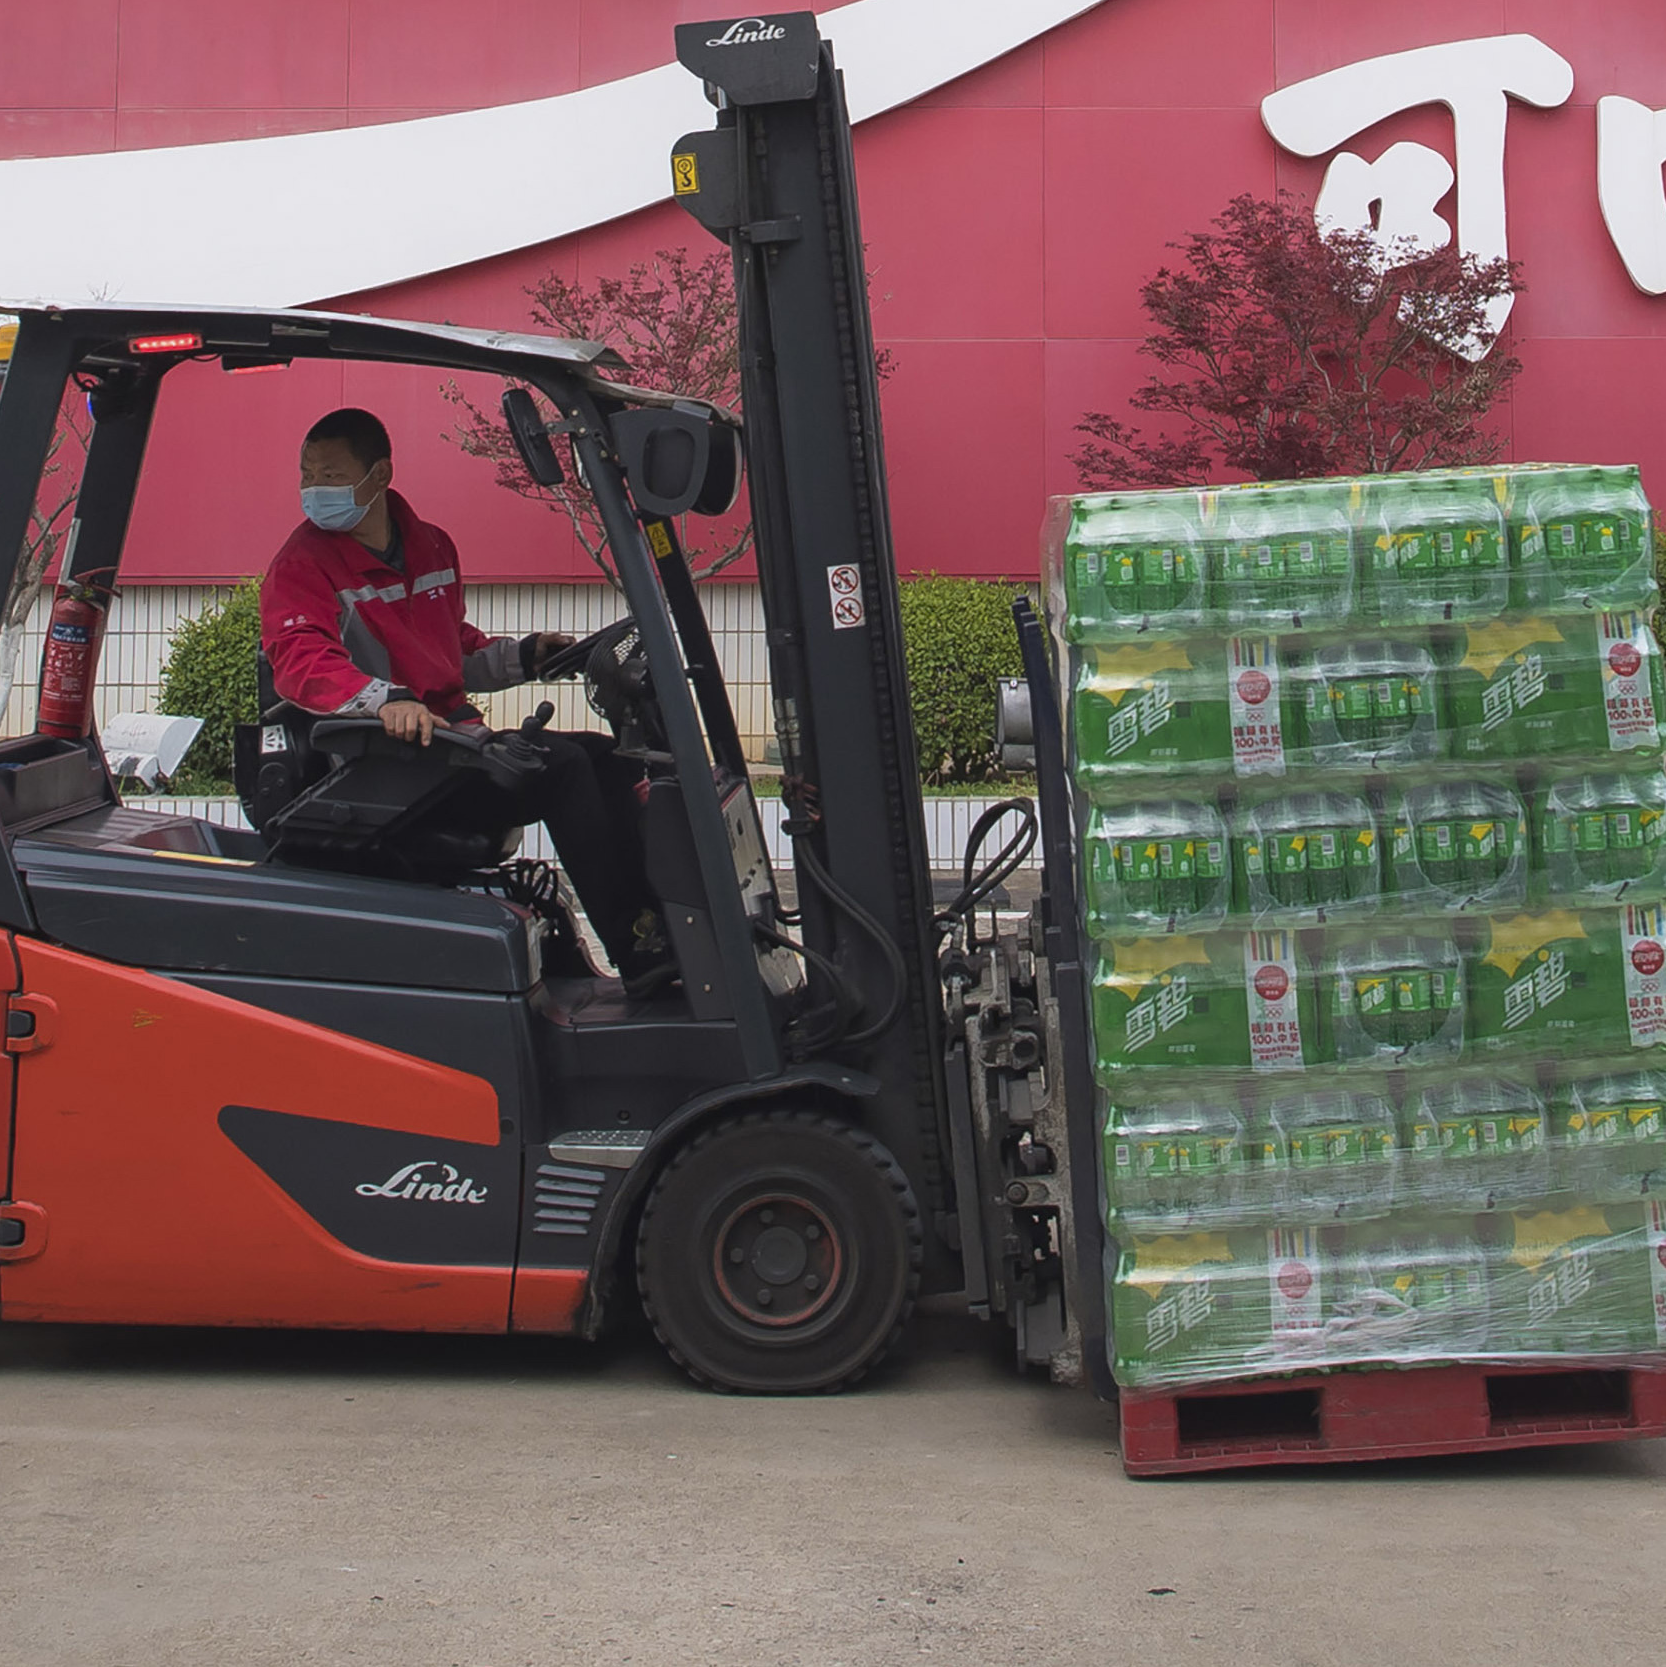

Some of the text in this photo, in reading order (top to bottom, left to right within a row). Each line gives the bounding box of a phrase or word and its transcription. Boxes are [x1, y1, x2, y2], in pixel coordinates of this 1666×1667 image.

[705, 17, 786, 47] Linde
[1105, 679, 1176, 758] 雪碧
[1480, 654, 1549, 732] 雪碧
[1123, 975, 1194, 1054] 雪碧
[1501, 950, 1571, 1030] 雪碧
[354, 1161, 488, 1204] Linde
